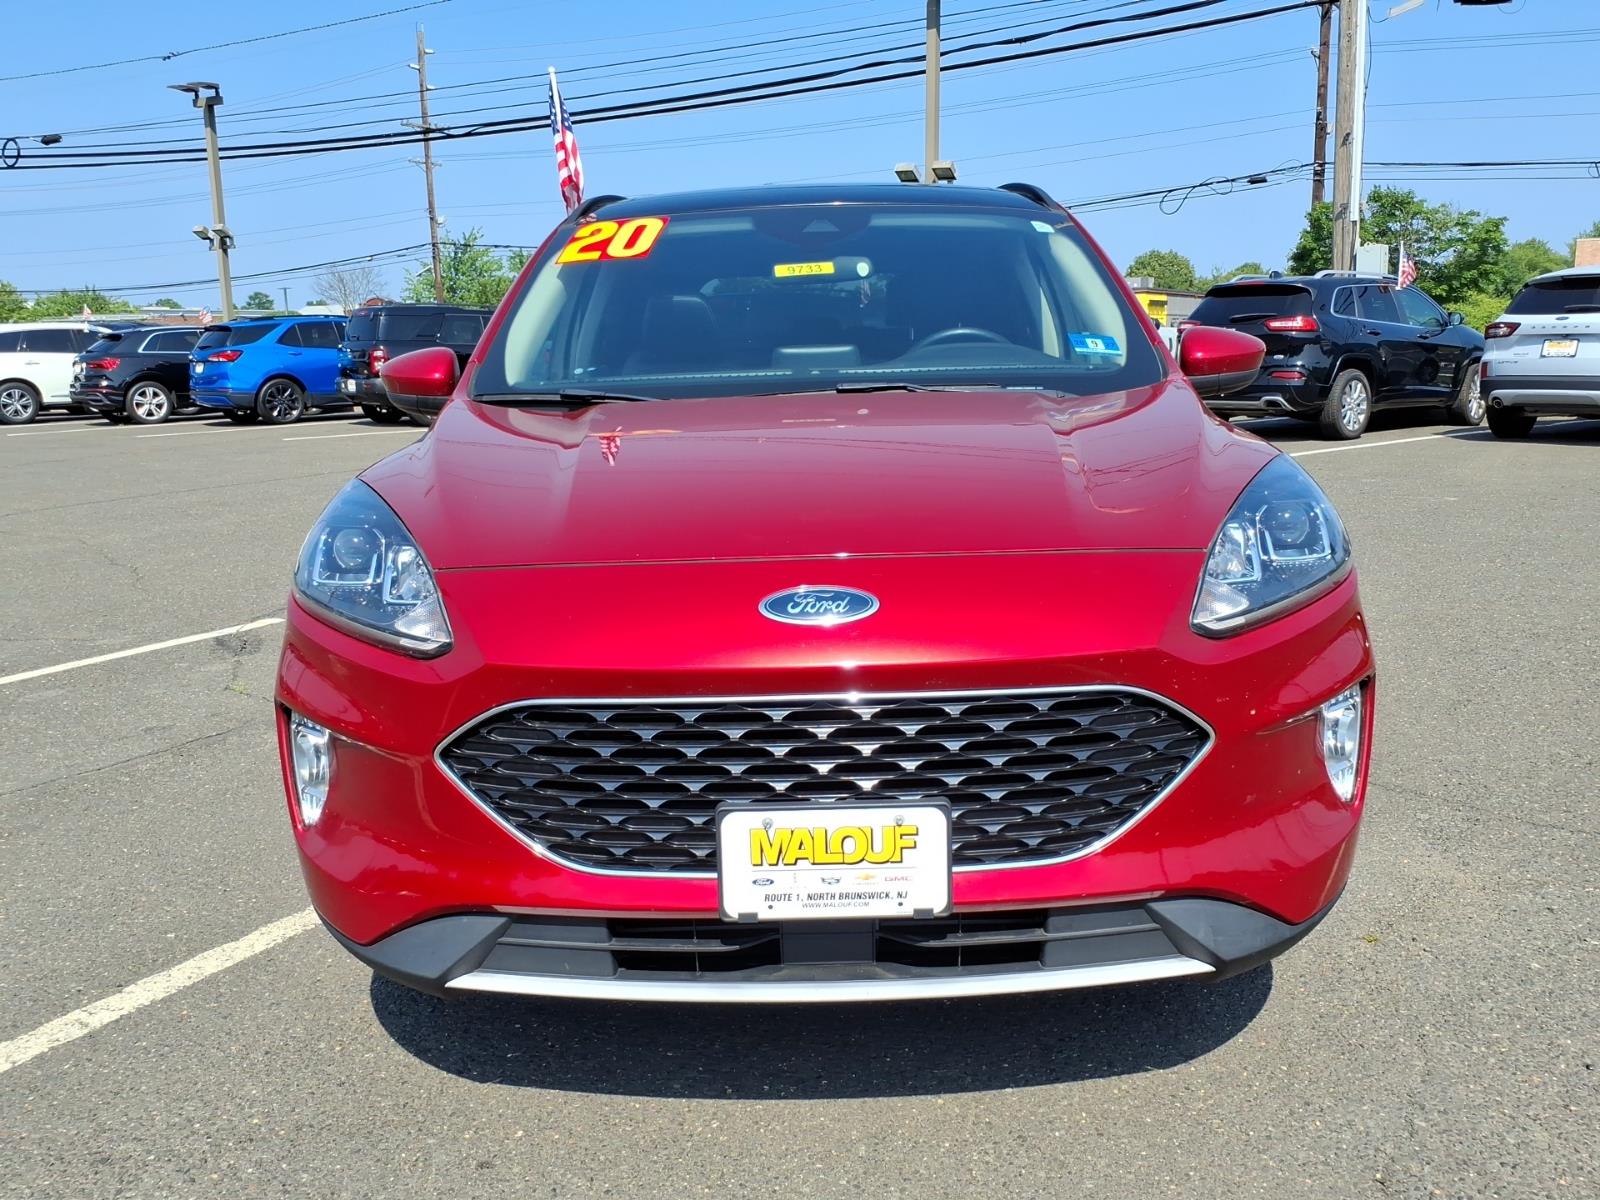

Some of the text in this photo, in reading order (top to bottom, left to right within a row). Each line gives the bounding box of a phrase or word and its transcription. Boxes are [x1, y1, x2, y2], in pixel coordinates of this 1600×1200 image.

[555, 217, 664, 264] 20
[786, 264, 823, 274] 9733
[787, 592, 850, 614] Ford
[749, 825, 919, 866] MALOUF
[764, 893, 793, 902] ROUTE
[806, 892, 836, 901] NORTH
[838, 890, 894, 900] BRUNSWICK,
[896, 890, 908, 899] NJ
[802, 901, 870, 909] WWW.MALOUF.COM
